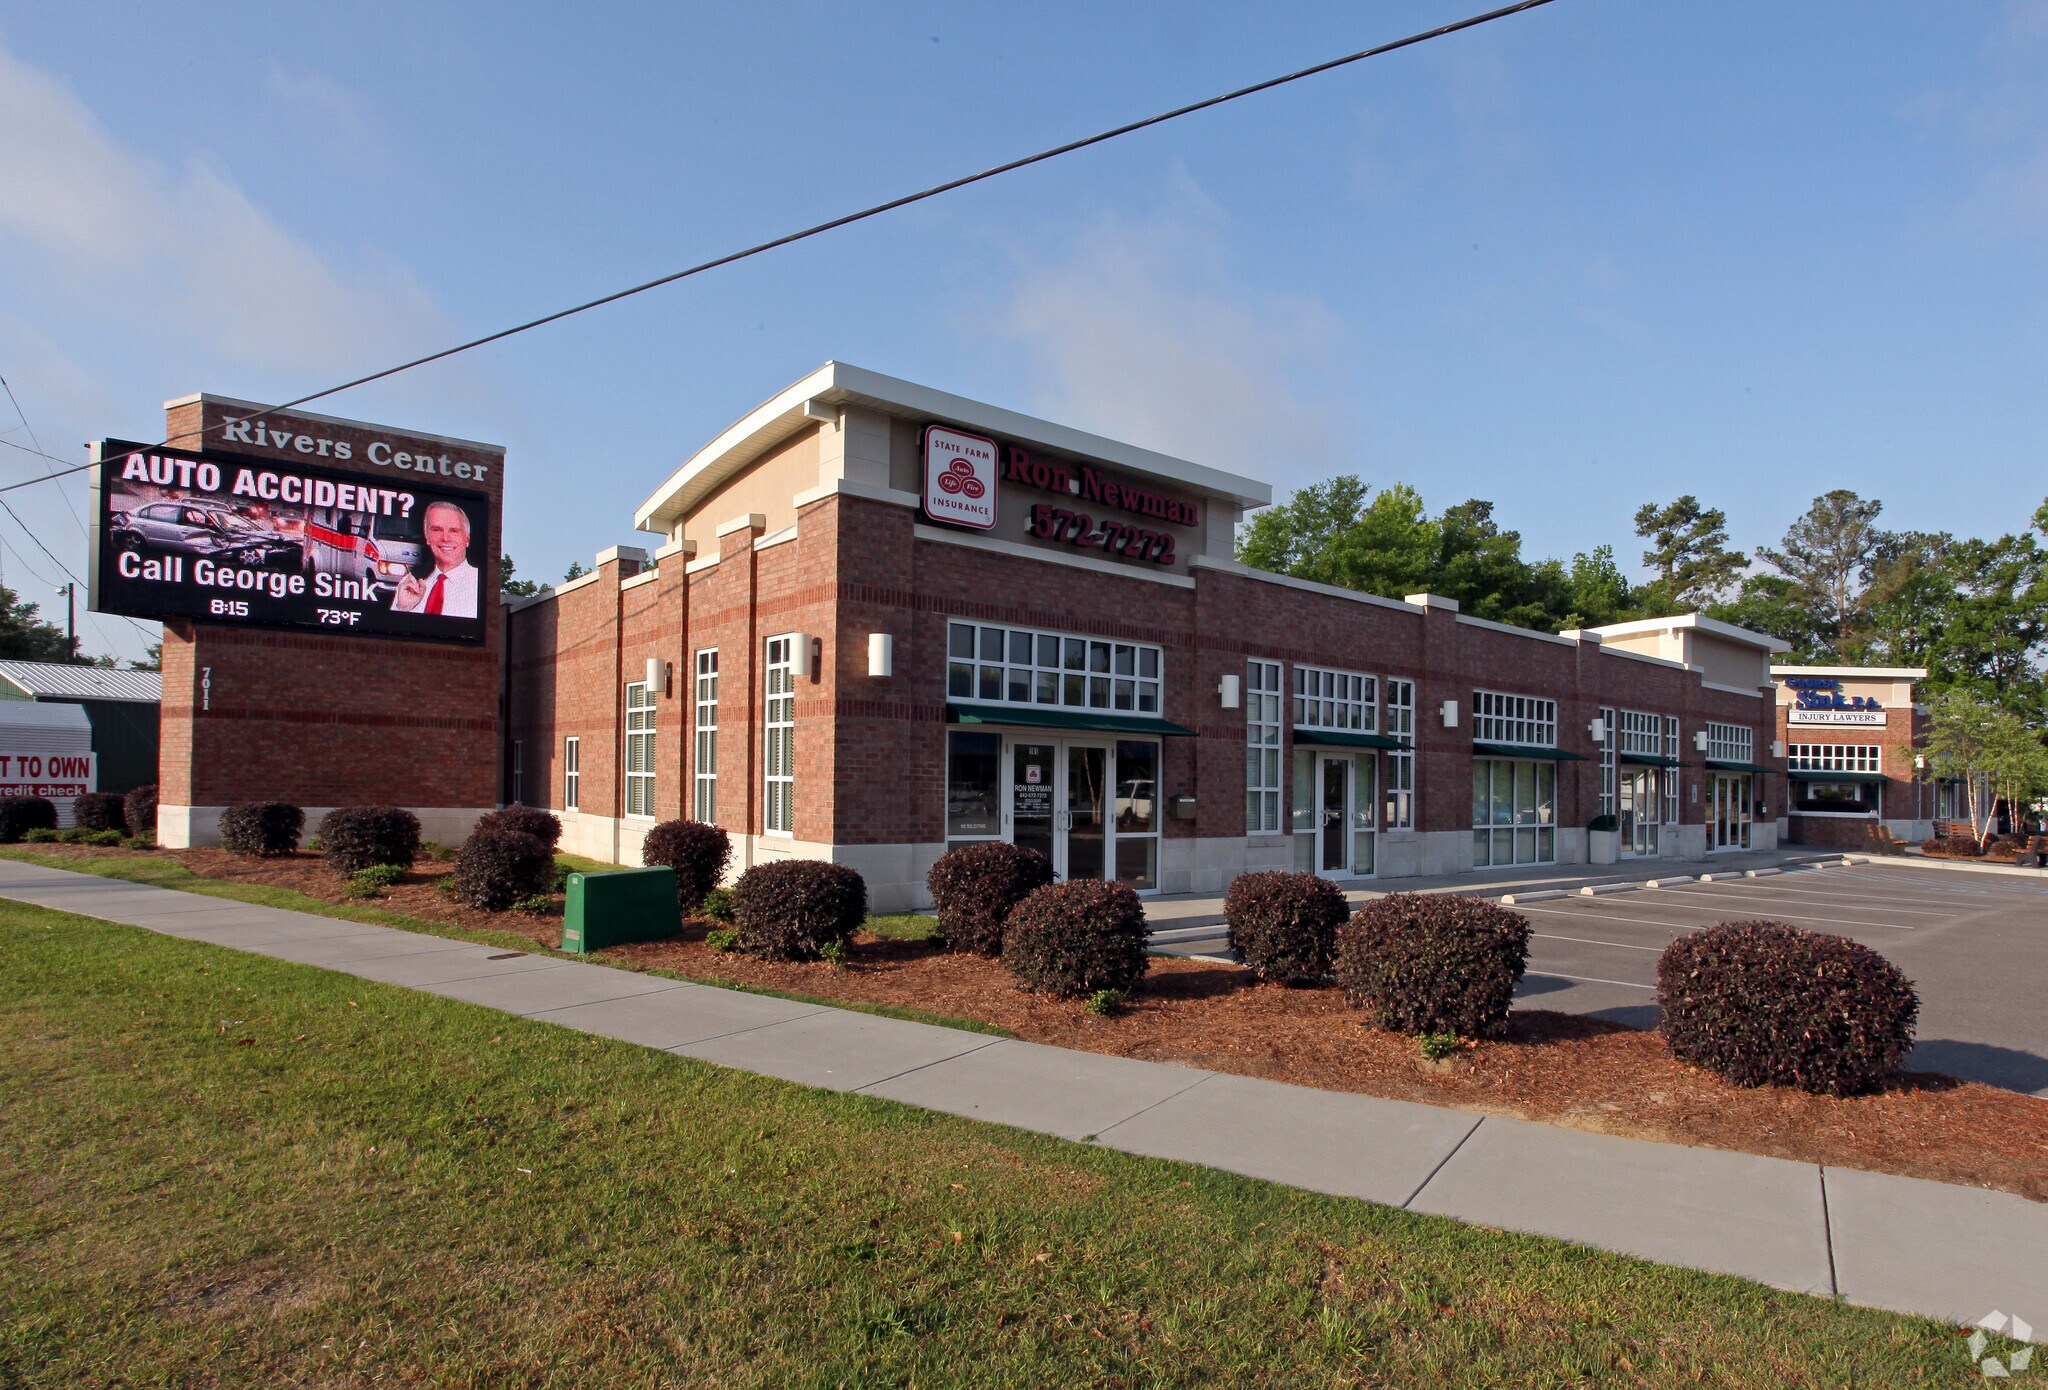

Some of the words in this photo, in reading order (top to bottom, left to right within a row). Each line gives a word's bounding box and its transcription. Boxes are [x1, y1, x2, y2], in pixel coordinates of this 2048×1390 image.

[221, 416, 352, 459] Rivers
[367, 442, 488, 482] Center
[934, 440, 961, 453] STATE
[965, 447, 990, 460] FARM
[955, 465, 970, 474] Auto
[121, 453, 221, 492] AUTO
[232, 469, 415, 518] ACCIDENT?
[944, 478, 957, 488] Life
[966, 483, 979, 492] Fire
[1008, 446, 1072, 494] Ron
[1082, 466, 1199, 527] Newman
[933, 497, 989, 515] INSURANCE
[1032, 504, 1176, 565] 572-7272
[118, 551, 183, 583] Call
[194, 559, 306, 597] George
[314, 571, 379, 602] Sink
[210, 599, 249, 617] 8:15
[201, 667, 211, 711] 7011
[1798, 713, 1831, 721] INJURY
[1833, 714, 1877, 722] LAWYERS
[17, 756, 42, 778] TO
[48, 756, 90, 778] OWN
[39, 784, 83, 796] check
[1014, 784, 1027, 792] RON
